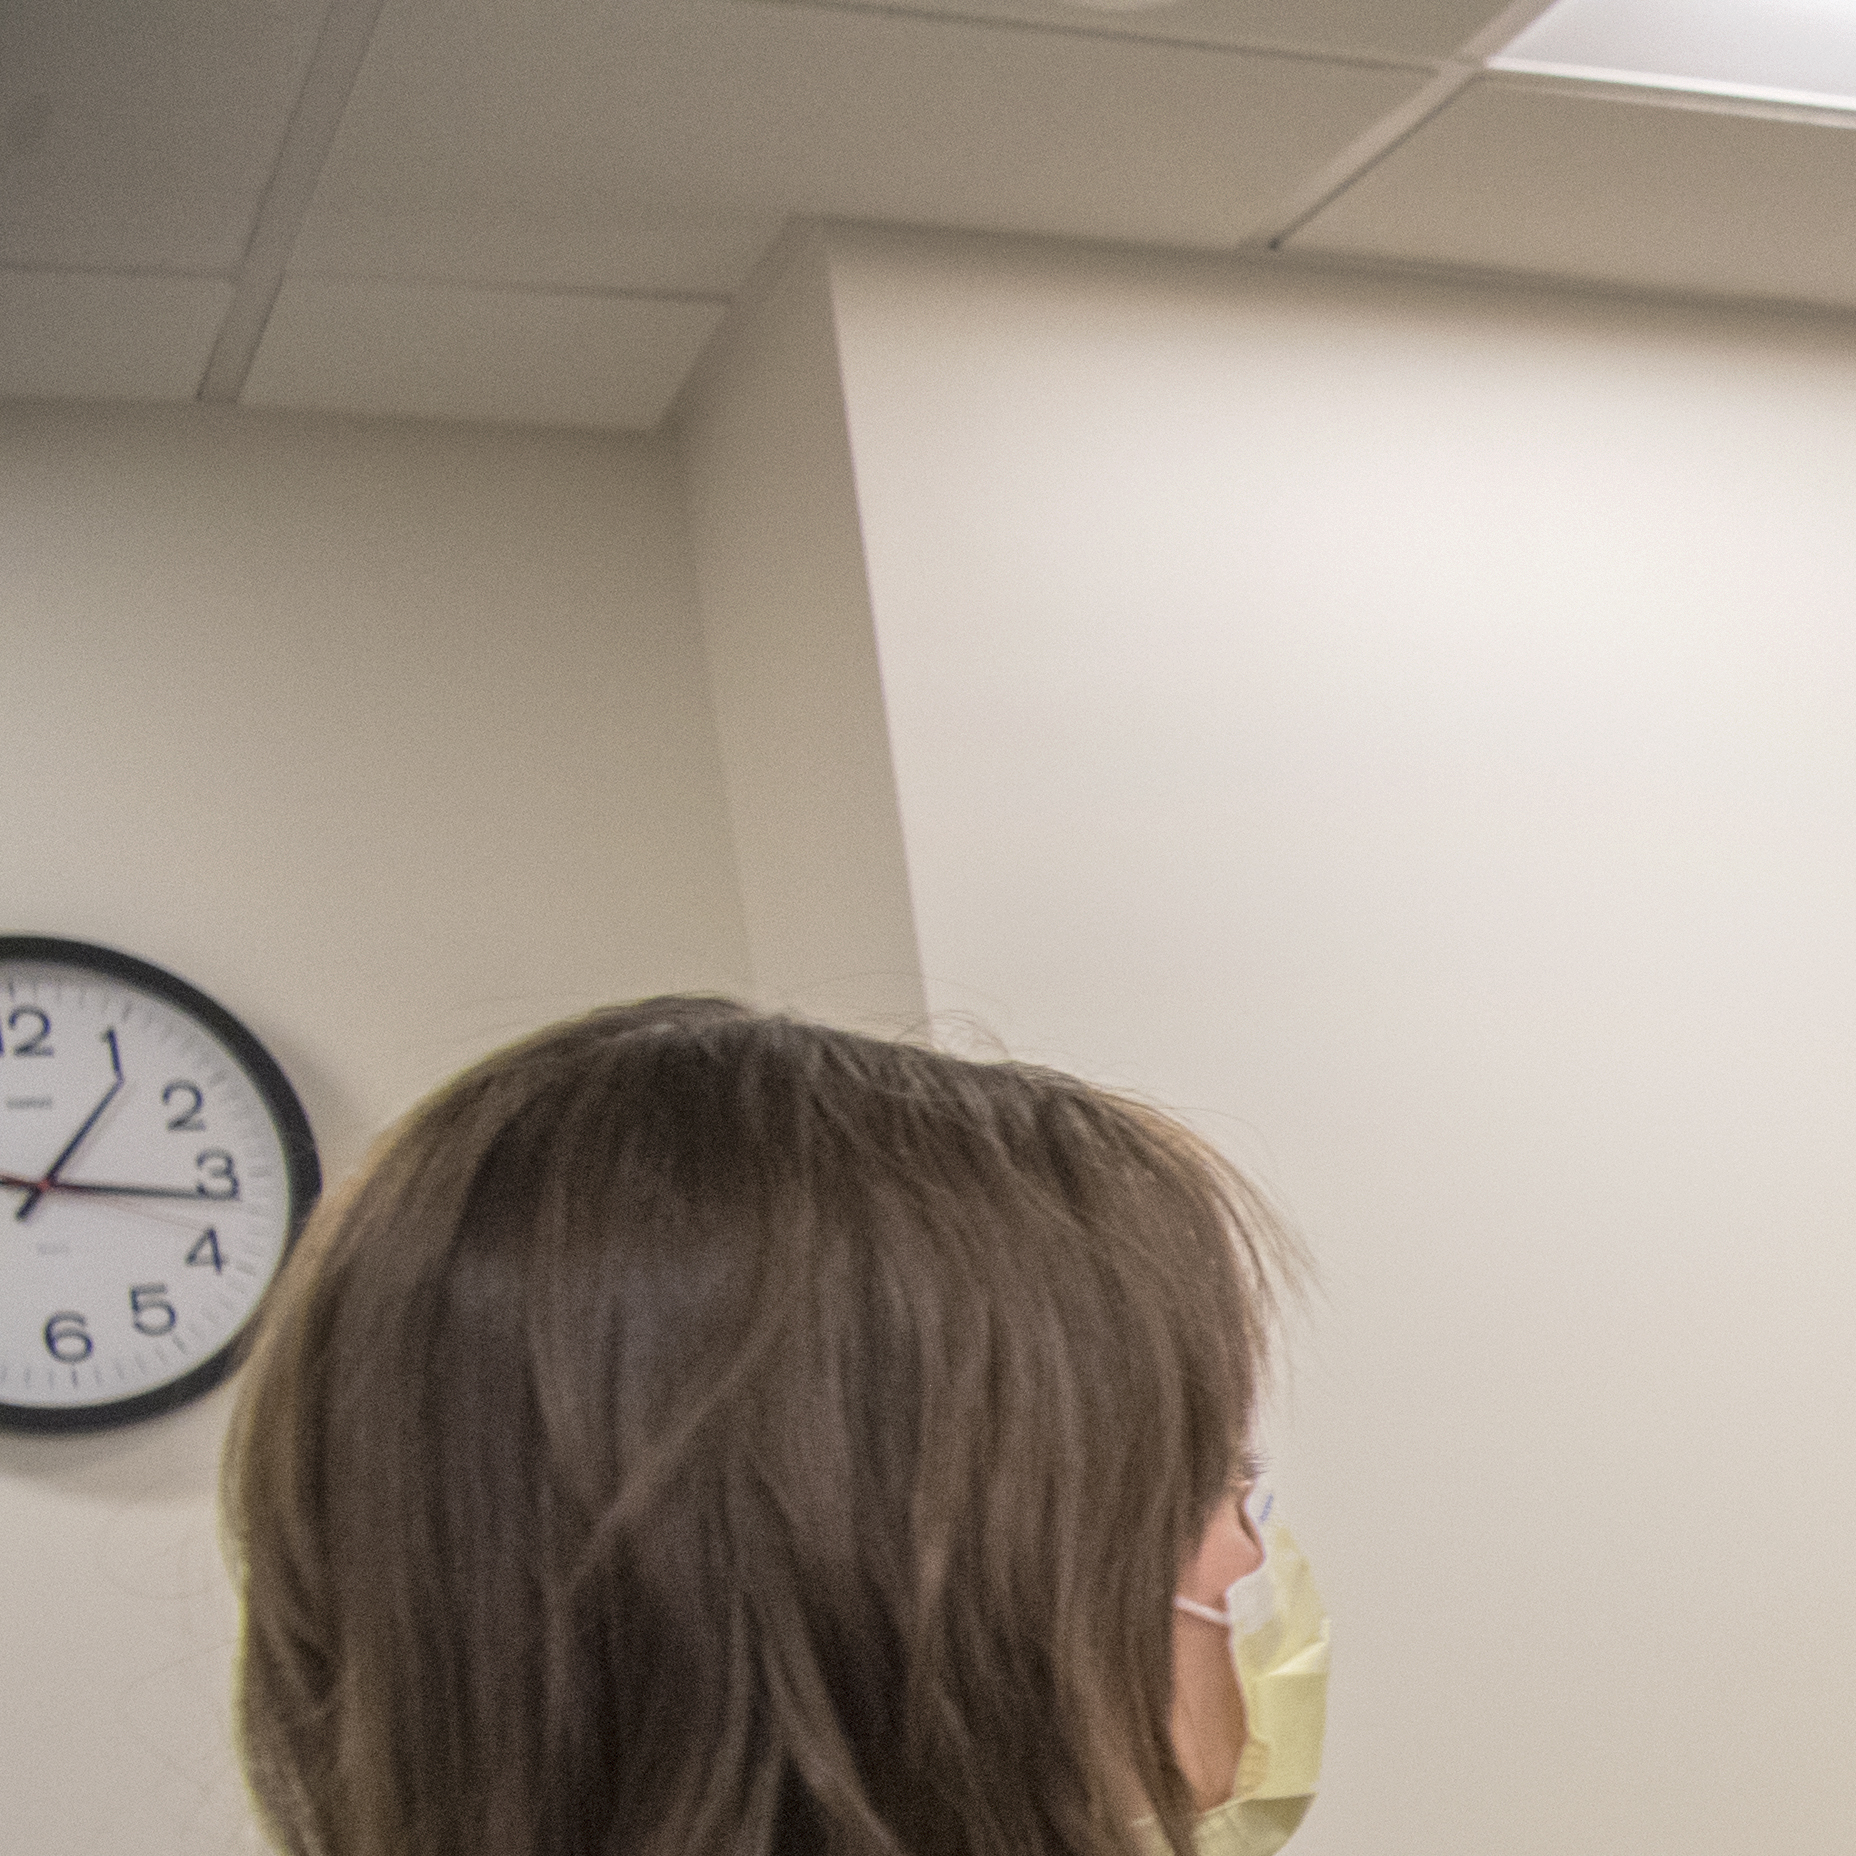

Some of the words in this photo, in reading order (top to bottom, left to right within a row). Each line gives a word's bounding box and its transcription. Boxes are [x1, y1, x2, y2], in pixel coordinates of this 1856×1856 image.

[161, 1077, 207, 1131] 2
[195, 1147, 241, 1201] 3
[185, 1225, 229, 1275] 4
[42, 1309, 94, 1364] 6
[129, 1283, 177, 1338] 5
